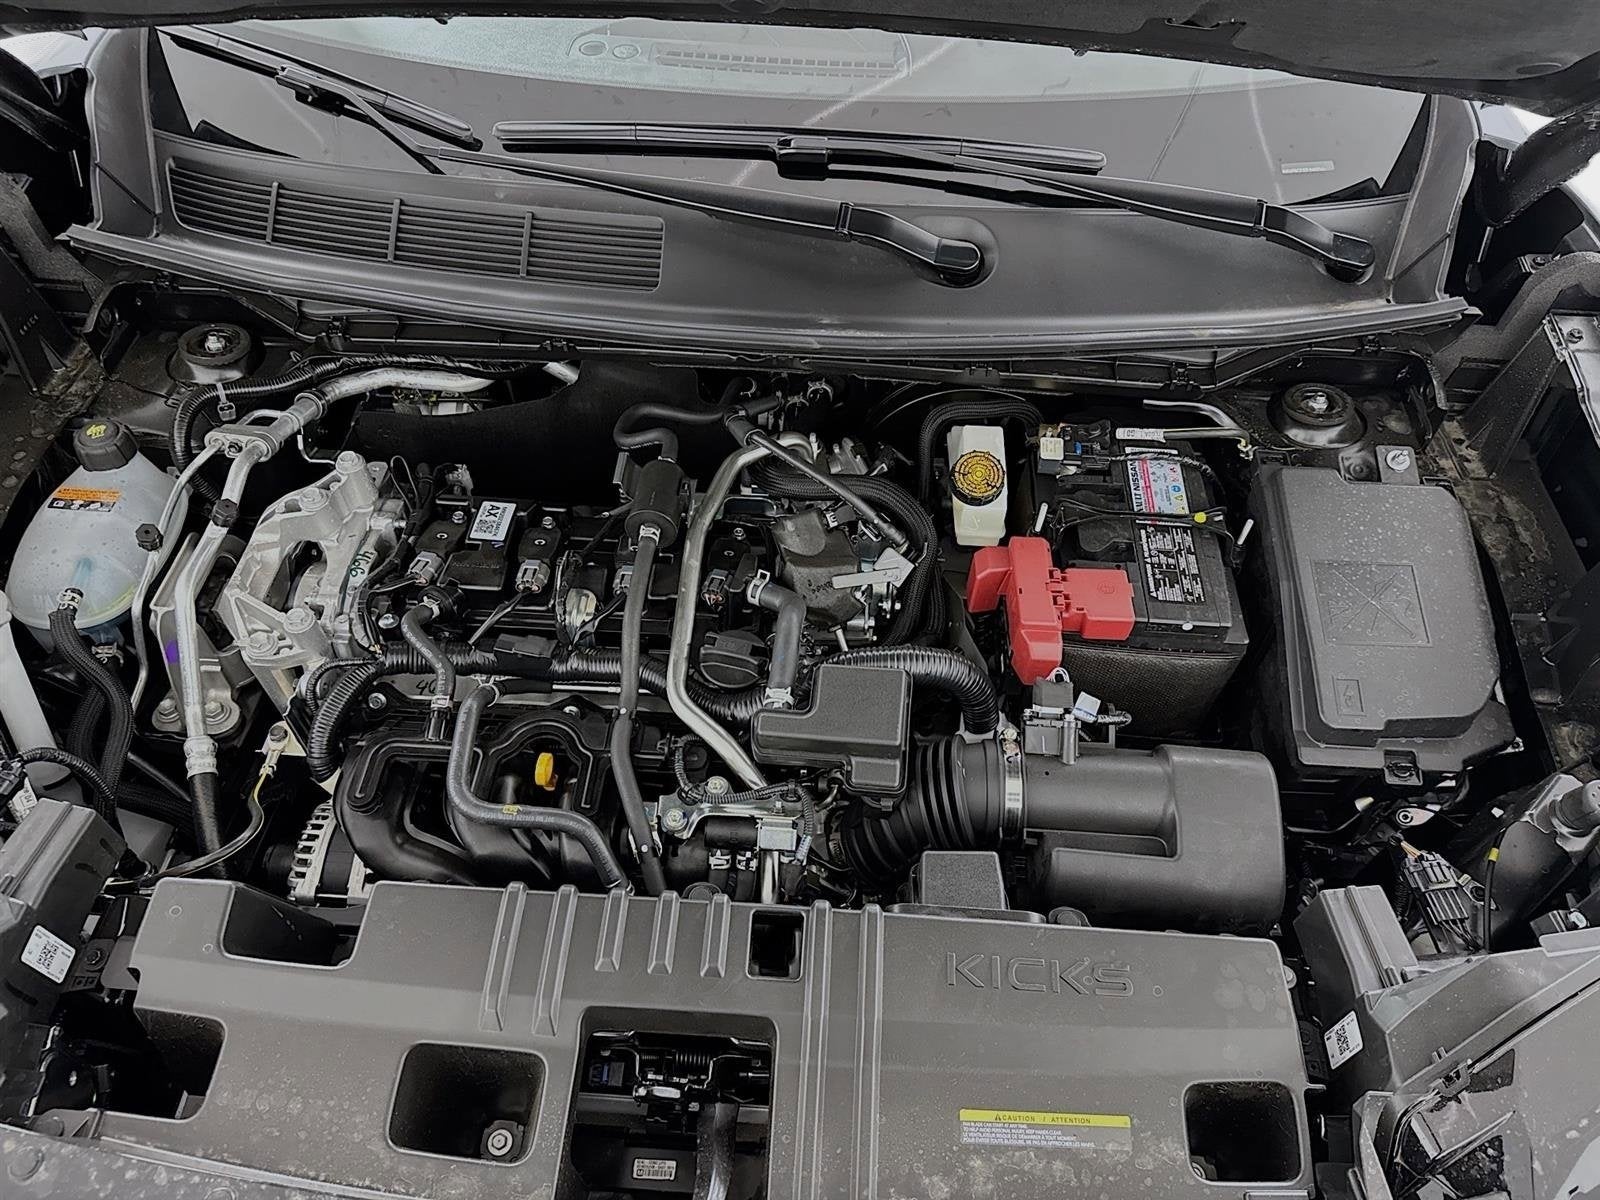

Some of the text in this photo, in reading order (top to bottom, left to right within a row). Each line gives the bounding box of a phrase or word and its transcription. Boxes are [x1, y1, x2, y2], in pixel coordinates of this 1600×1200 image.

[485, 504, 501, 518] AX
[947, 952, 1134, 997] KICKS
[1002, 1114, 1035, 1122] CAUTION
[1051, 1116, 1091, 1124] ATTENTION
